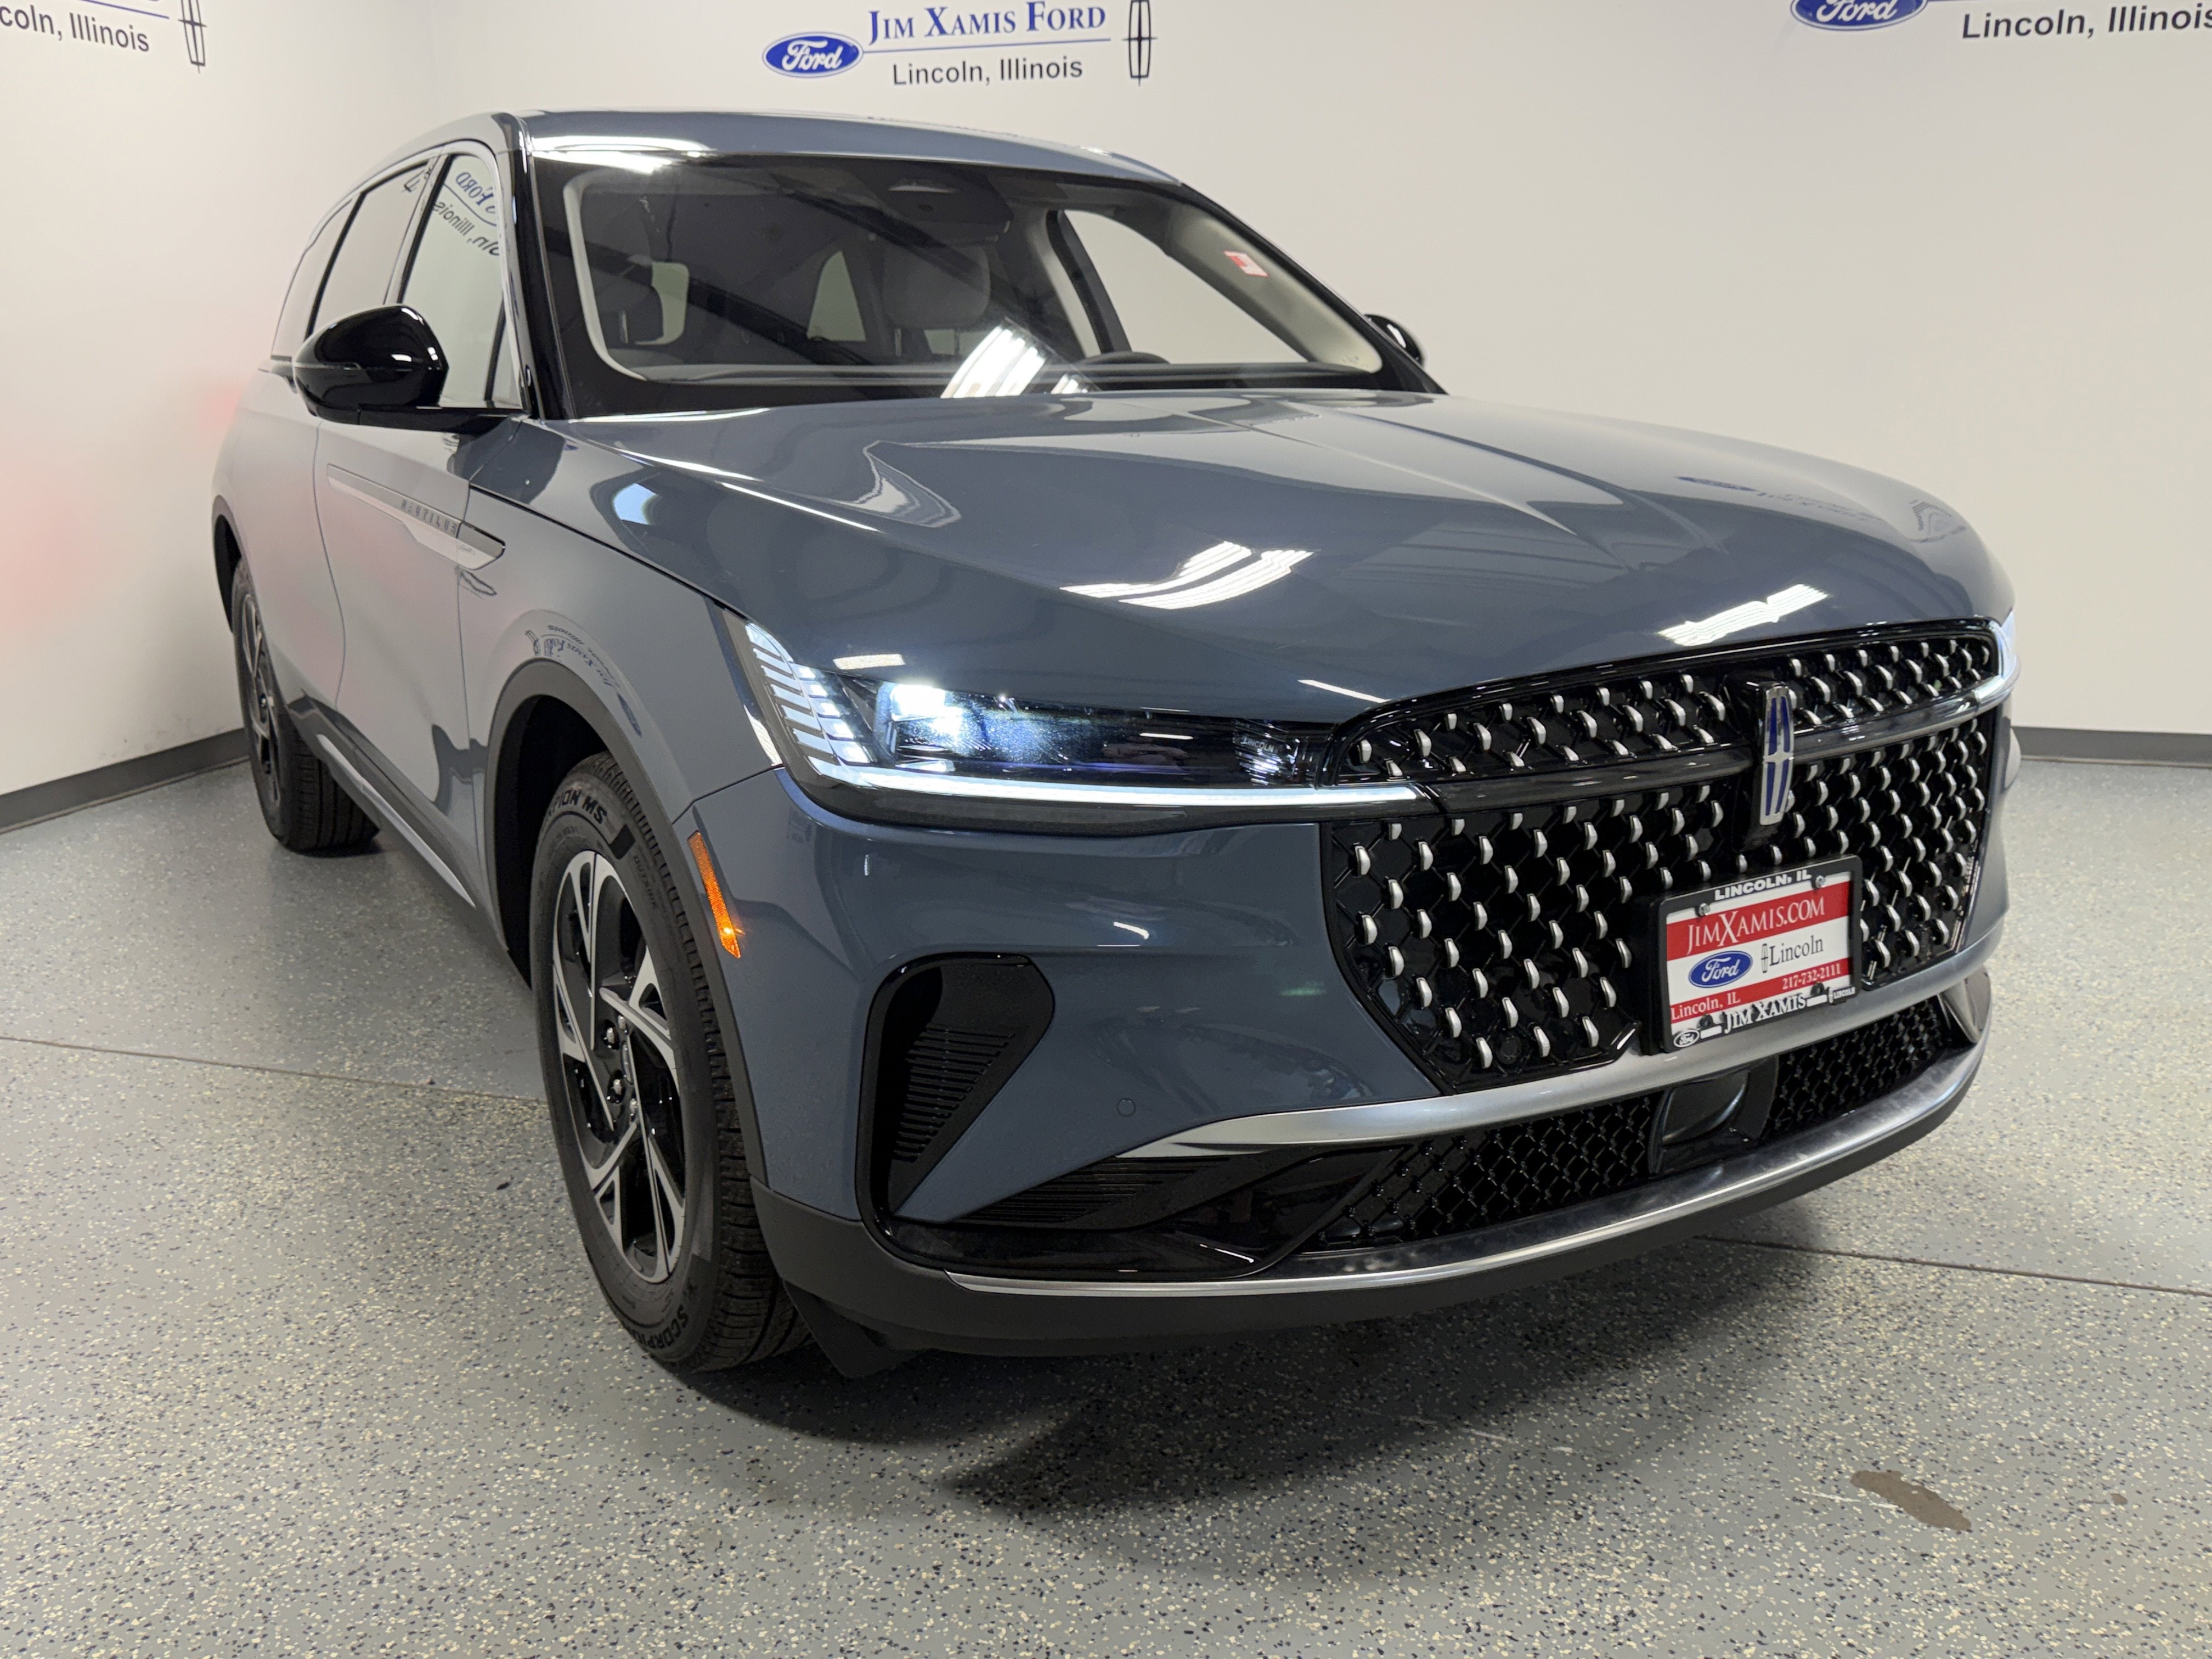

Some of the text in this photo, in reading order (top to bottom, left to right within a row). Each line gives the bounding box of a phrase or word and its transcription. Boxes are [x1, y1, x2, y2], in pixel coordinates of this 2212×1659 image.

[0, 5, 149, 52] coln, Illinois
[868, 1, 1106, 46] JIM XAMIS FORD
[1962, 9, 2094, 38] Lincoln,
[782, 40, 844, 71] Ford
[893, 56, 1083, 86] Lincoln, Illinois
[1715, 870, 1812, 901] LINCOLN, IL
[1686, 896, 1825, 955] JIMXAMIS.COM
[1769, 935, 1824, 967] Lincoln
[1702, 957, 1740, 983] Ford
[1782, 963, 1841, 990] 217-732-2111
[1671, 992, 1741, 1020] Lincoln, IL
[1724, 995, 1806, 1034] JIM XAMIS
